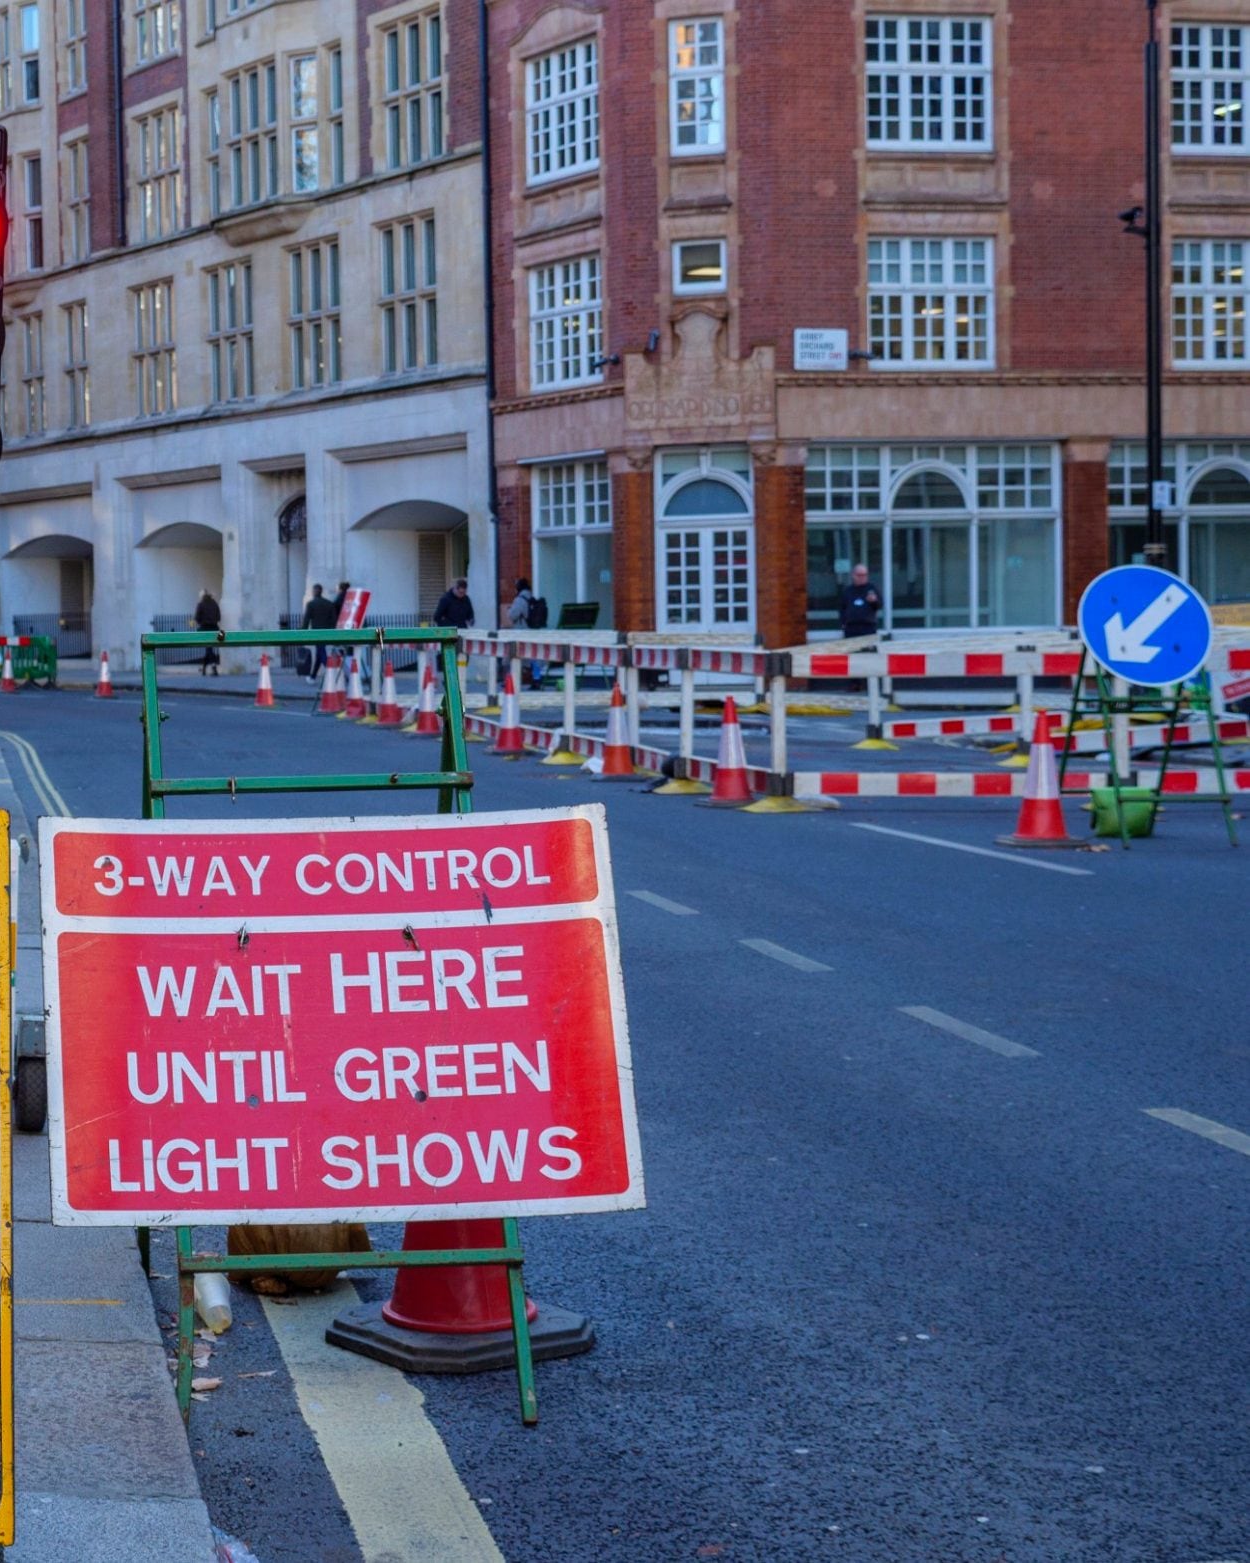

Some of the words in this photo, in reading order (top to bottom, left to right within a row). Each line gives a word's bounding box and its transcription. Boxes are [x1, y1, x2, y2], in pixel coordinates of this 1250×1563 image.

[800, 342, 834, 350] ORCHARD
[800, 352, 826, 360] STREET
[93, 854, 271, 897] 3-WAY
[295, 845, 551, 896] CONTROL
[136, 964, 301, 1017] WAIT
[330, 945, 528, 1014] HERE
[127, 1051, 306, 1105] UNTIL
[334, 1040, 551, 1101] GREEN
[108, 1137, 288, 1193] LIGHT
[320, 1126, 583, 1191] SHOWS
